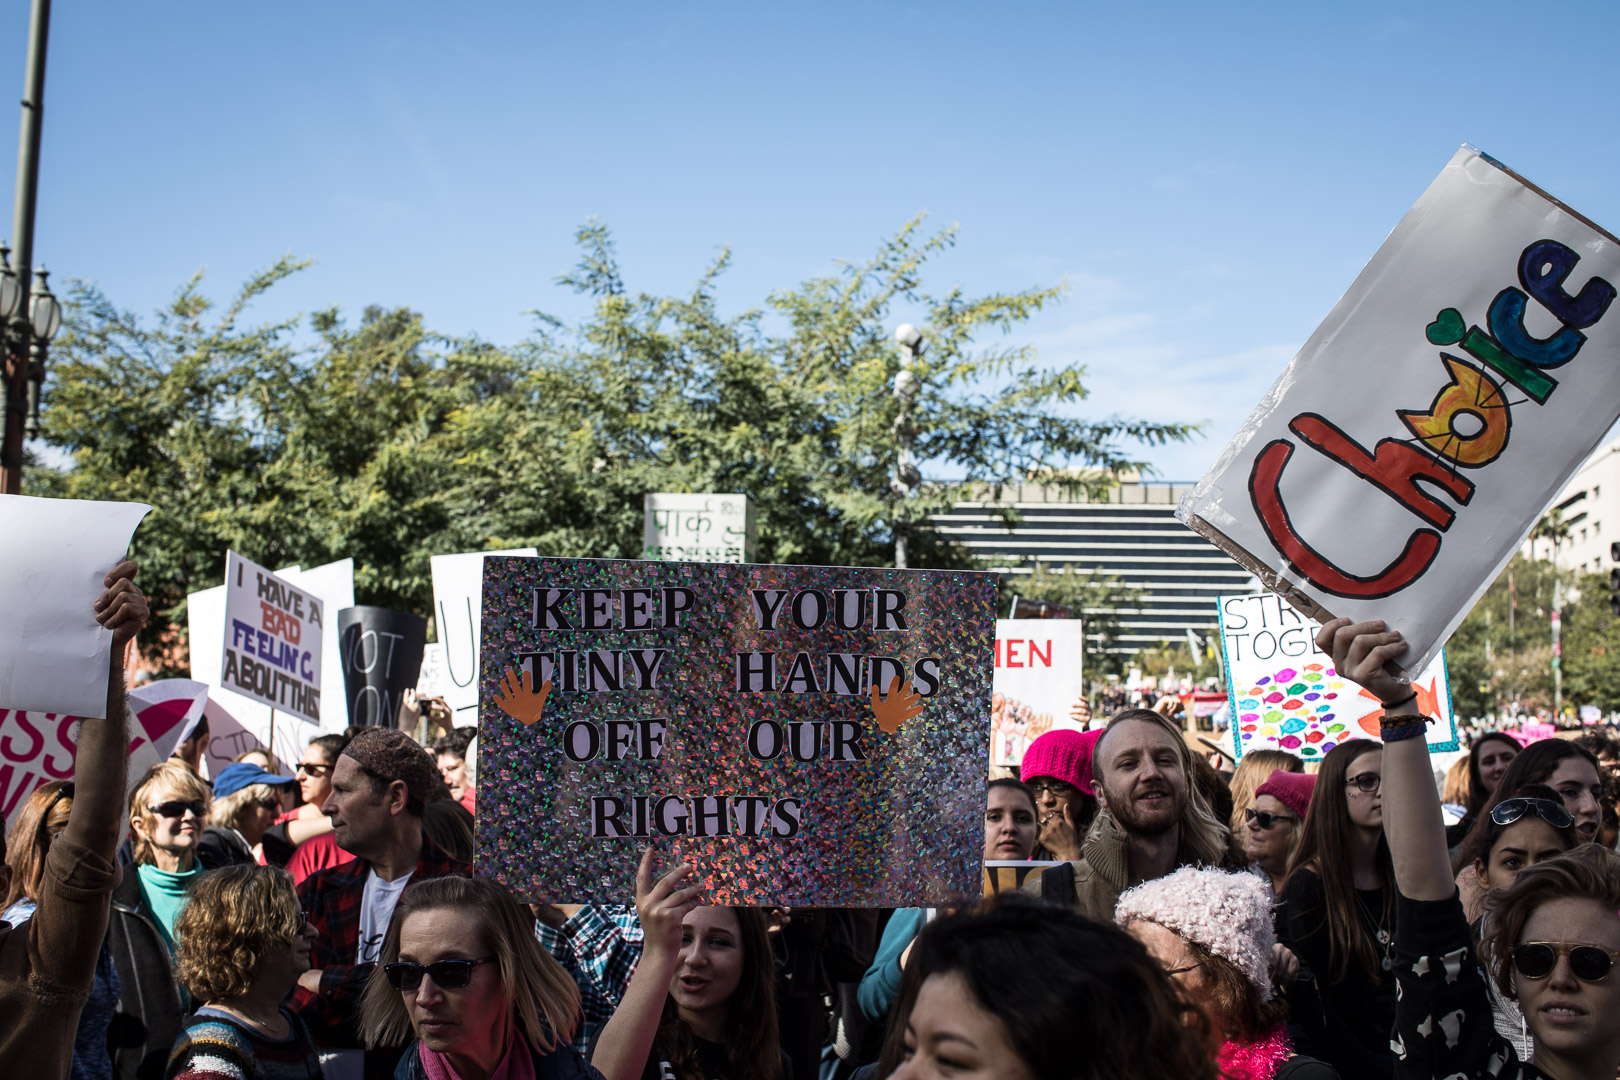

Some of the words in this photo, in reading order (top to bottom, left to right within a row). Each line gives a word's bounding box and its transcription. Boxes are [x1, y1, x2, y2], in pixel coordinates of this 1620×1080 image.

[1248, 239, 1617, 599] Choice
[237, 563, 243, 587] I
[257, 572, 304, 619] HAVE
[308, 600, 323, 630] A
[532, 587, 696, 631] KEEP
[751, 588, 909, 631] YOUR
[260, 601, 301, 645] BAD
[232, 619, 313, 681] FEELING
[518, 650, 666, 694] TINY
[736, 651, 941, 698] HANDS
[563, 718, 667, 762] OFF
[747, 719, 867, 762] OUR
[592, 795, 801, 839] RIGHTS
